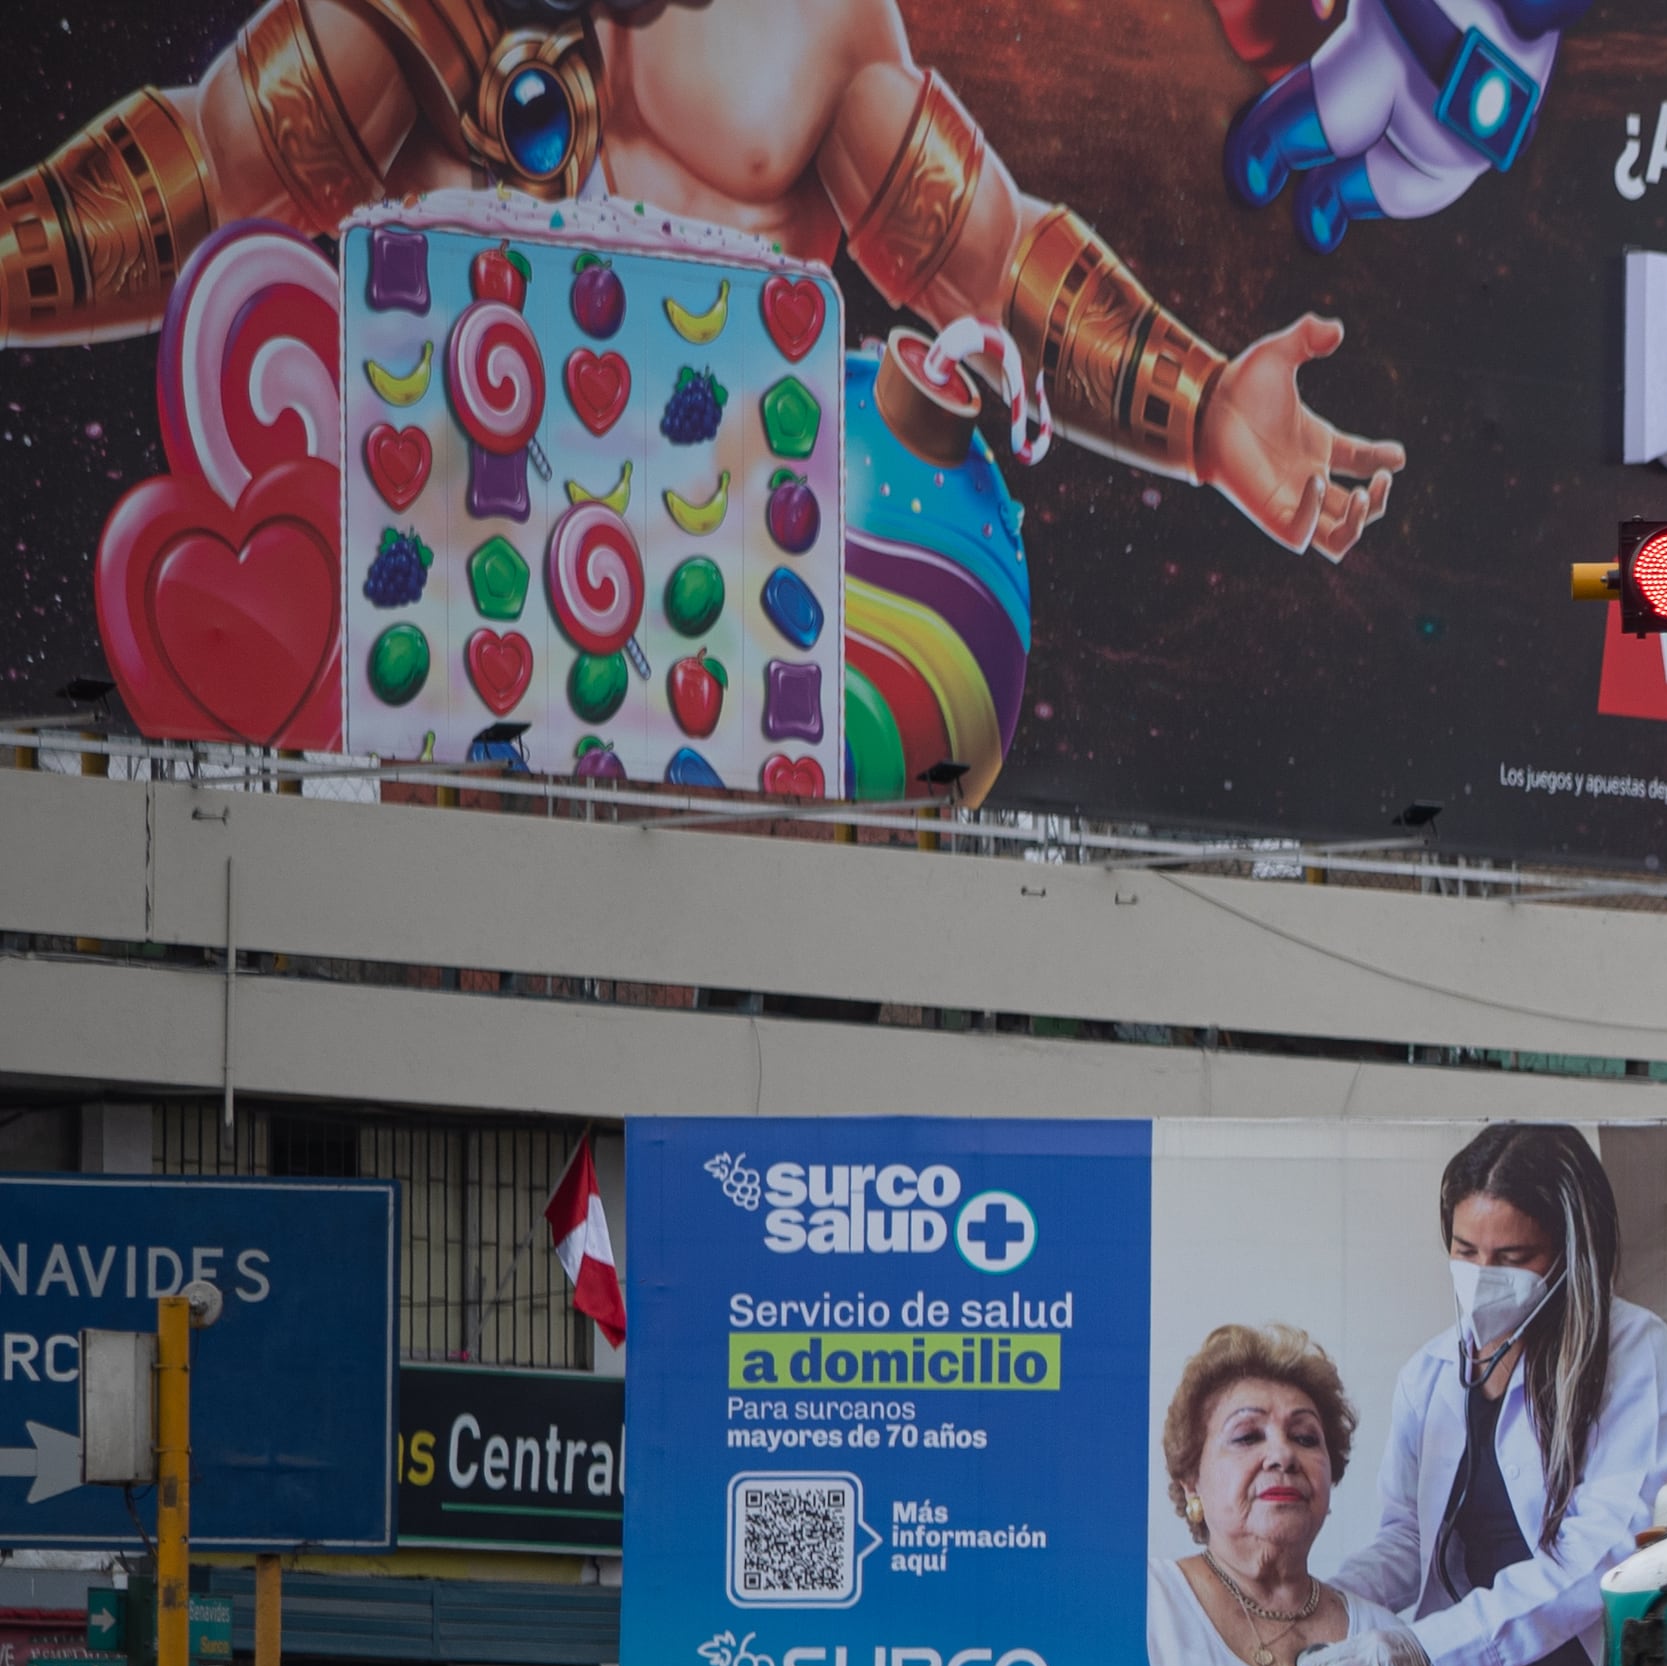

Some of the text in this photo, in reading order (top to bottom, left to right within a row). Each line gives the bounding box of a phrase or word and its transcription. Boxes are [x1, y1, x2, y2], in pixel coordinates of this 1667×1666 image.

[1500, 762, 1524, 788] Los
[1525, 766, 1573, 795] juegos
[1574, 774, 1584, 796] y
[1586, 773, 1646, 799] apuestas
[729, 1290, 1073, 1329] Servicio de salud
[742, 1337, 1048, 1385] a domicilio
[727, 1396, 916, 1421] Para surcanos
[727, 1422, 988, 1453] mayores de 70 años
[892, 1499, 949, 1524] Más
[891, 1524, 1047, 1549] información
[890, 1549, 948, 1577] aquí
